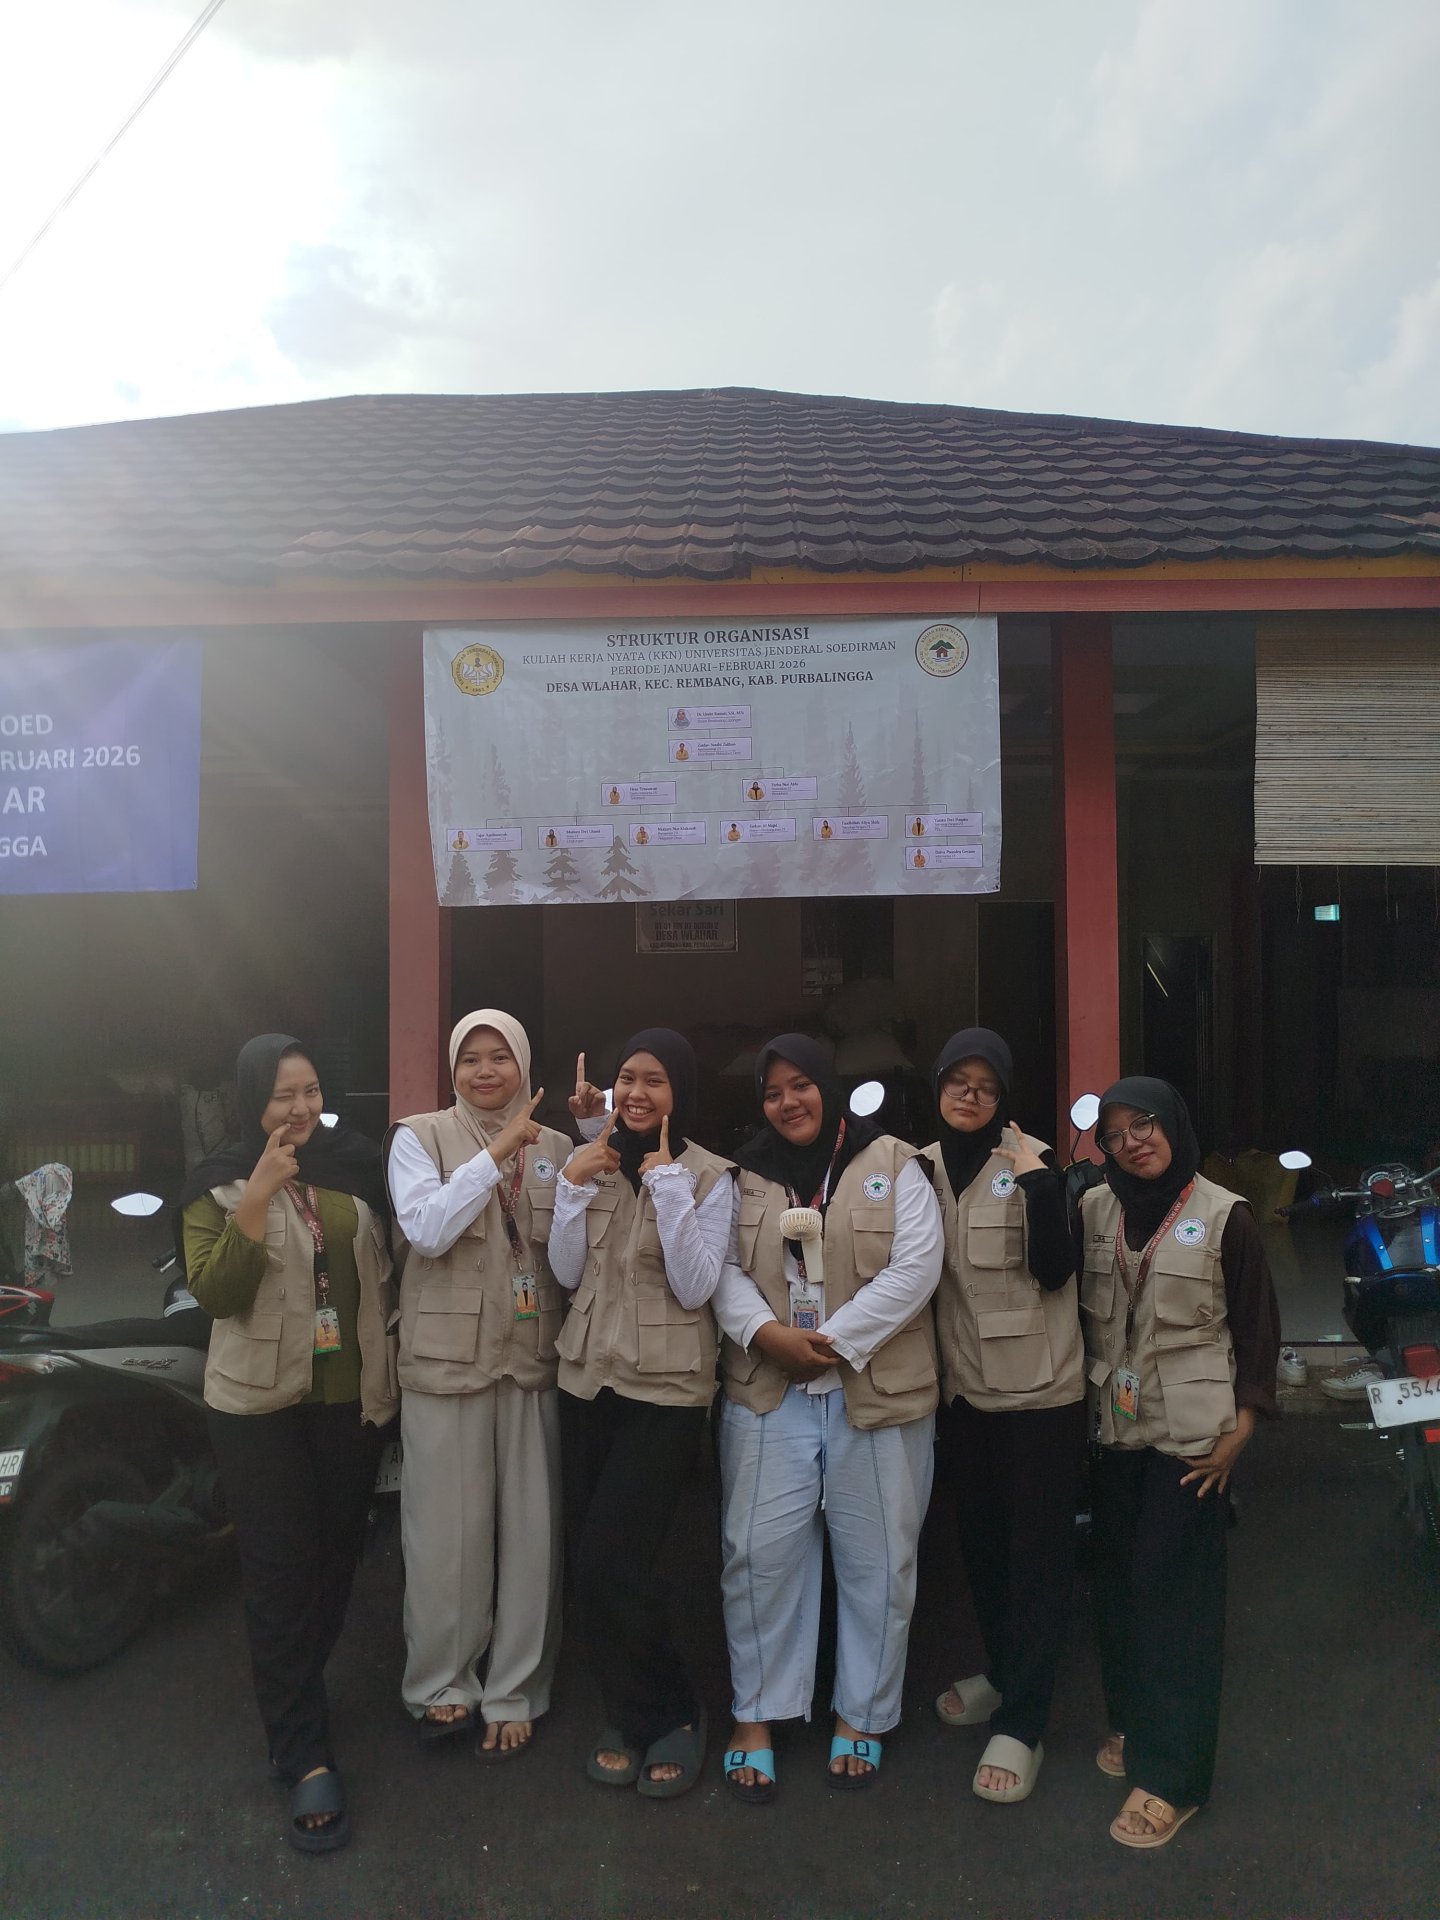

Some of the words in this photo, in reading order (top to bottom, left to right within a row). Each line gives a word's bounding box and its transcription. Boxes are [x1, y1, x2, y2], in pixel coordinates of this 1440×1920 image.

[606, 631, 700, 648] STRUKTUR
[703, 627, 810, 644] ORGANISASI
[522, 654, 566, 665] KULIAH
[569, 653, 605, 664] KERJA
[606, 651, 646, 662] NYATA
[648, 650, 682, 662] (KKN)
[685, 647, 762, 659] UNIVERSITAS
[764, 644, 823, 658] JENDERAL
[826, 640, 897, 654] SOEDIRMAN
[610, 664, 661, 676] PERIODE
[778, 658, 806, 669] 2026
[546, 680, 580, 693] DESA
[581, 679, 641, 693] WLAHAR,
[644, 678, 673, 690] KEC.
[676, 676, 745, 689] REMBANG,
[748, 673, 778, 686] KAB.
[781, 671, 874, 685] PURBALINGGA
[82, 745, 141, 767] 2026
[650, 901, 692, 917] Sekar
[695, 901, 724, 916] Sari
[655, 929, 678, 941] DESA
[681, 929, 719, 941] WLAHAR
[1370, 1387, 1383, 1404] R
[0, 1455, 19, 1474] HR
